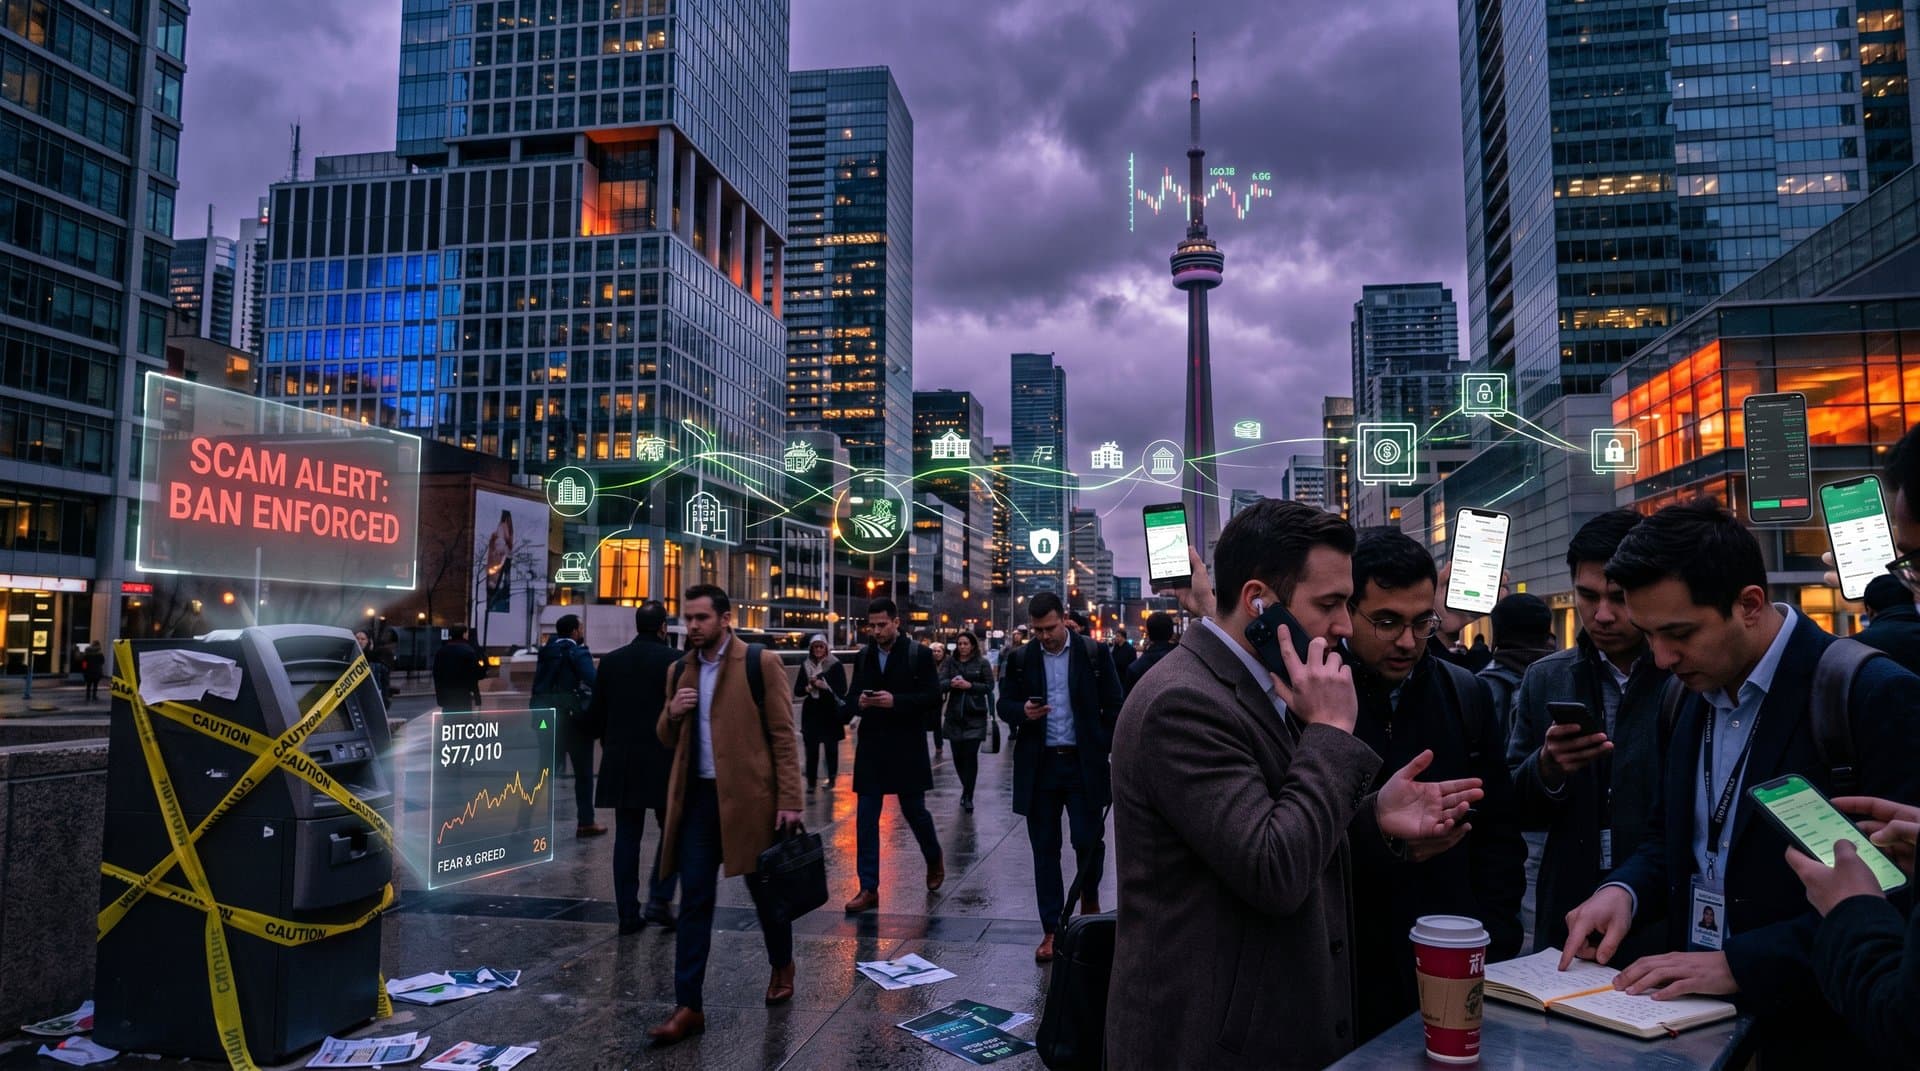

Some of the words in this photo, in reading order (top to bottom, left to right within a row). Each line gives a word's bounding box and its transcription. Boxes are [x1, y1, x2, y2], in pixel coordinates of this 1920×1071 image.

[190, 437, 286, 487] SCAM
[294, 457, 390, 503] ALERT:
[169, 481, 242, 526] BAN
[252, 494, 400, 545] ENFORCED
[192, 713, 251, 746] CAUTION
[271, 709, 322, 759] CAUTION
[442, 722, 499, 742] BITCOIN
[440, 742, 502, 767] $77,010
[533, 836, 547, 852] 26
[437, 857, 463, 873] FEAR
[465, 855, 473, 866] &
[474, 848, 505, 865] GREED
[265, 922, 327, 942] CAUTION
